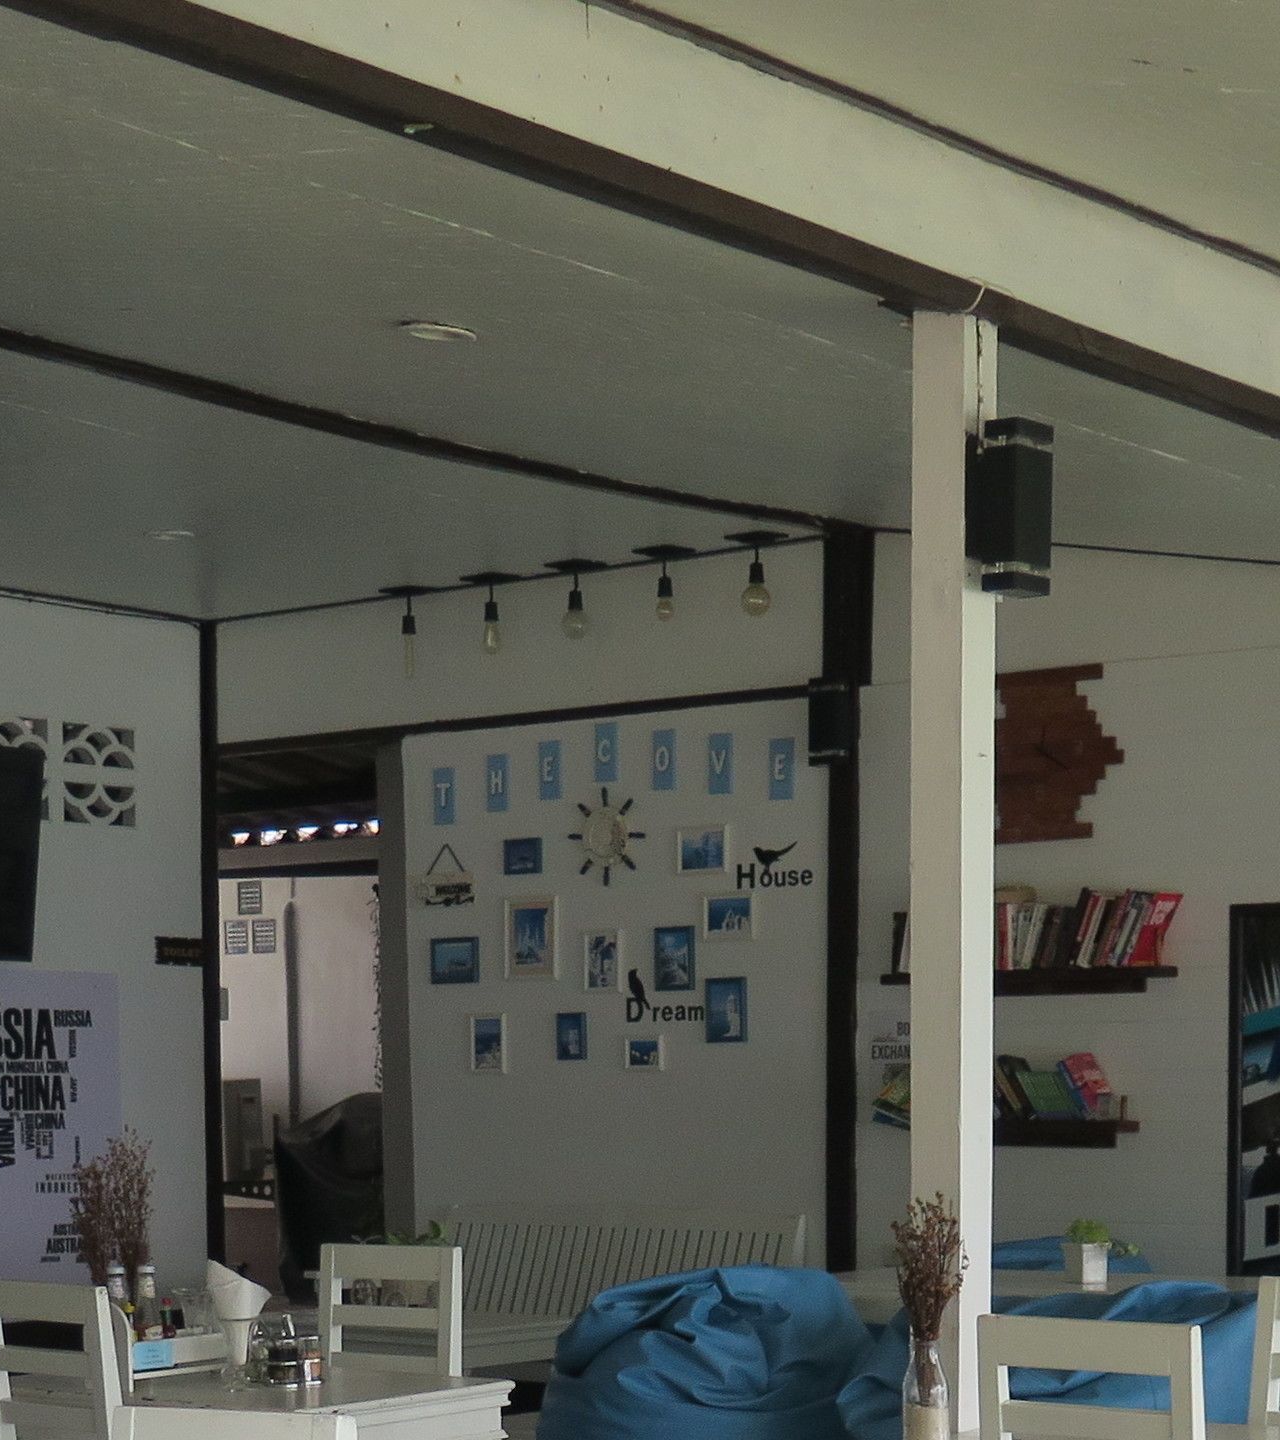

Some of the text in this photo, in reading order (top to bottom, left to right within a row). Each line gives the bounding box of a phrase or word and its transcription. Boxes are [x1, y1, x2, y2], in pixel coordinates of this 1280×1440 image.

[736, 863, 813, 890] House
[53, 1009, 93, 1028] RUSSIA
[625, 997, 705, 1022] Dream
[871, 1044, 910, 1060] EXCHAN
[0, 1074, 67, 1112] CHINA
[34, 1112, 67, 1130] CHINA
[35, 1181, 81, 1194] INDONES
